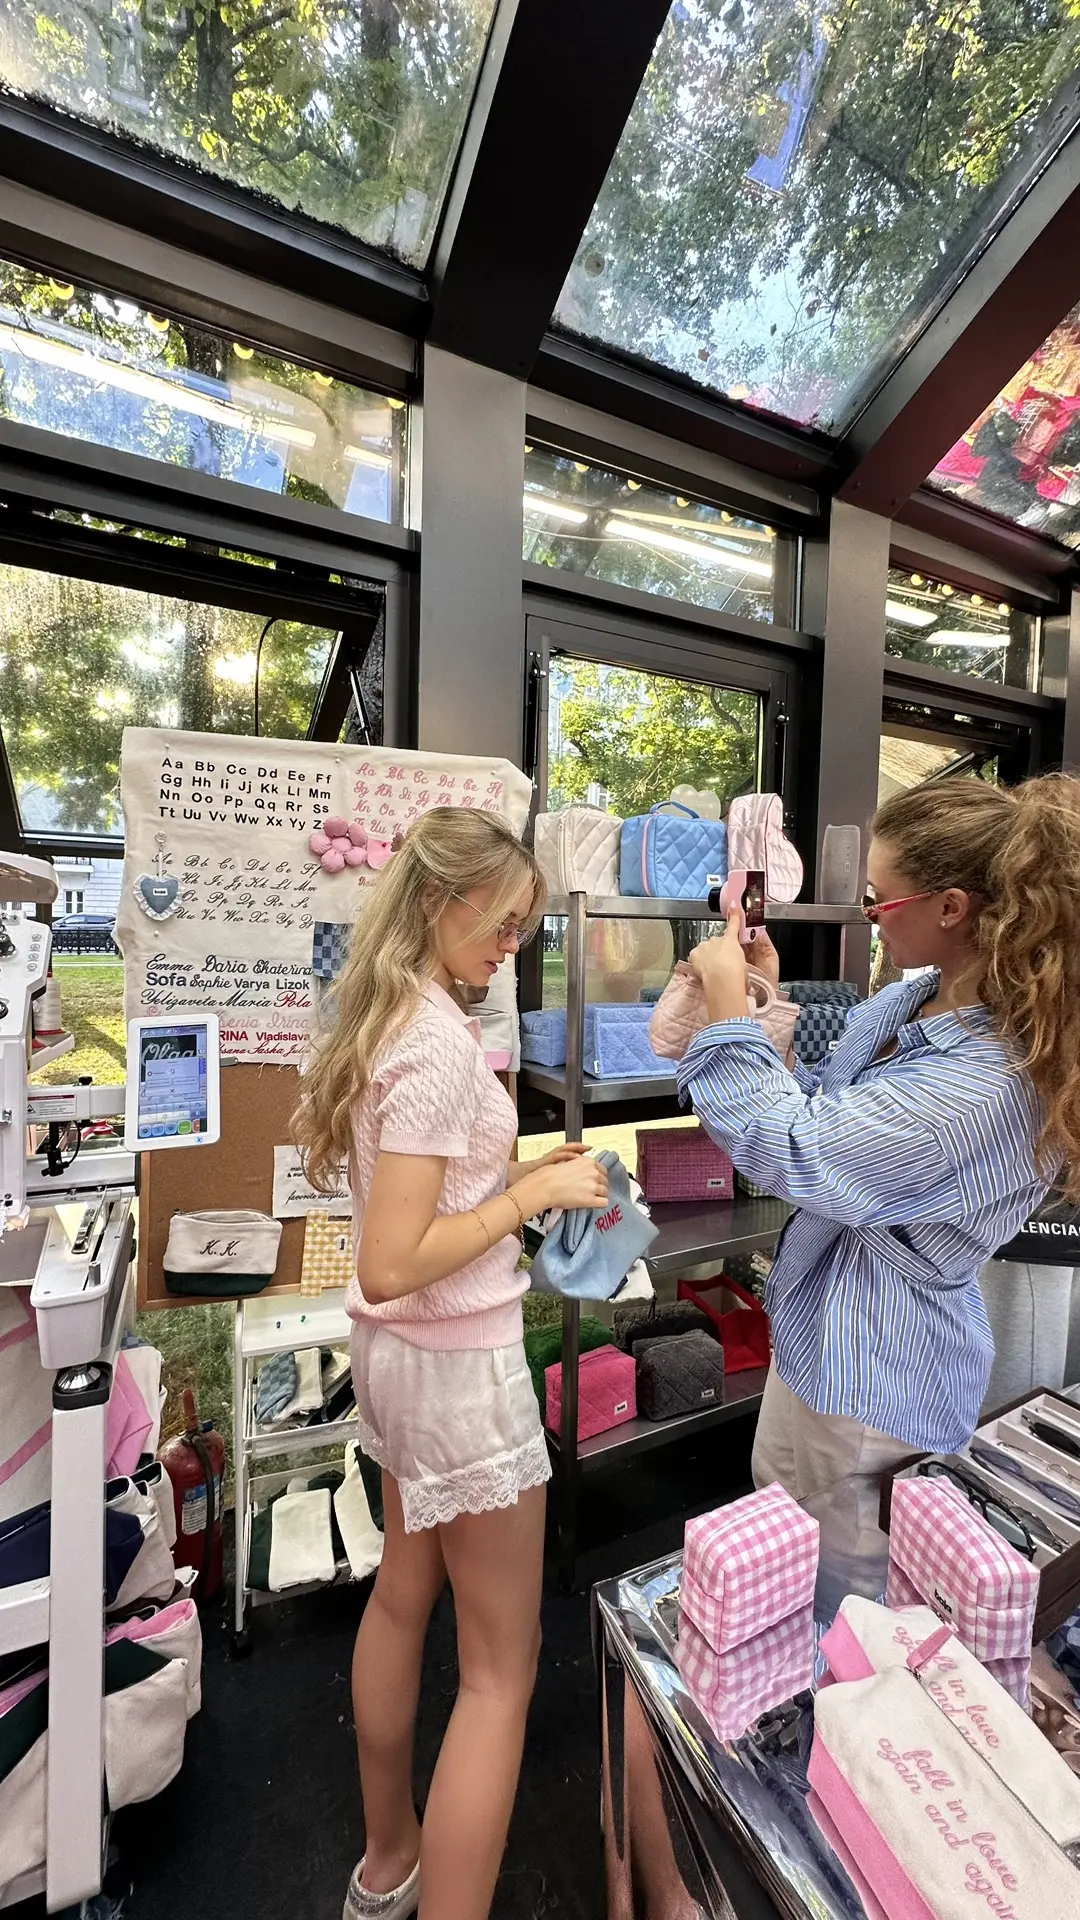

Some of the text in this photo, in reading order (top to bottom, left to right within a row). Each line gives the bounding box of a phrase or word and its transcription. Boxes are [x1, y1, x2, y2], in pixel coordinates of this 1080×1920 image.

[162, 757, 332, 784] Aa Bb Cc Dd Ee Ff
[161, 773, 331, 799] Gg Hh Ii Jj Kk Ll Mm
[160, 789, 329, 814] Nn Oo Pp Qq Rr Ss
[159, 806, 325, 831] Tt Uu Vv Ww Xx Yy Z
[145, 953, 313, 976] Emma Daria Ekaterina
[145, 972, 310, 993] Sofa Sophie Varya Lizok
[140, 988, 313, 1011] Yelizaveta Maria Pola
[256, 1031, 310, 1042] Vladislava
[1020, 1221, 1080, 1237] LENCIA
[199, 1239, 241, 1257] K. K.
[946, 1798, 969, 1824] in
[924, 1803, 970, 1851] and
